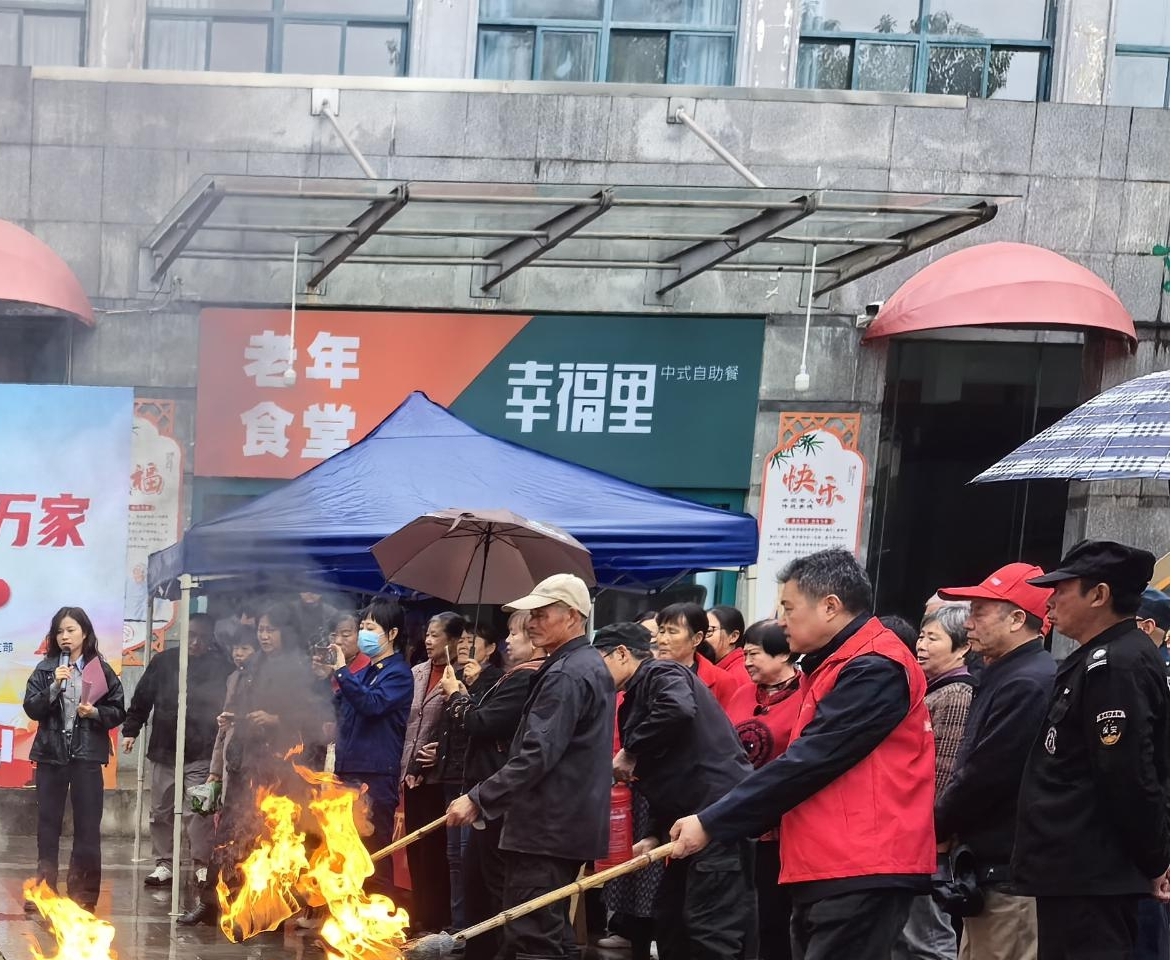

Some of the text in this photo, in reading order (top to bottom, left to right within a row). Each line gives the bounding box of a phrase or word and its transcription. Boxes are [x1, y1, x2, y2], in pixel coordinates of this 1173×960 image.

[242, 330, 360, 388] 老年
[660, 365, 739, 382] 中式自助餐
[505, 361, 657, 433] 幸福里
[240, 401, 356, 458] 食堂
[782, 463, 845, 508] 快乐
